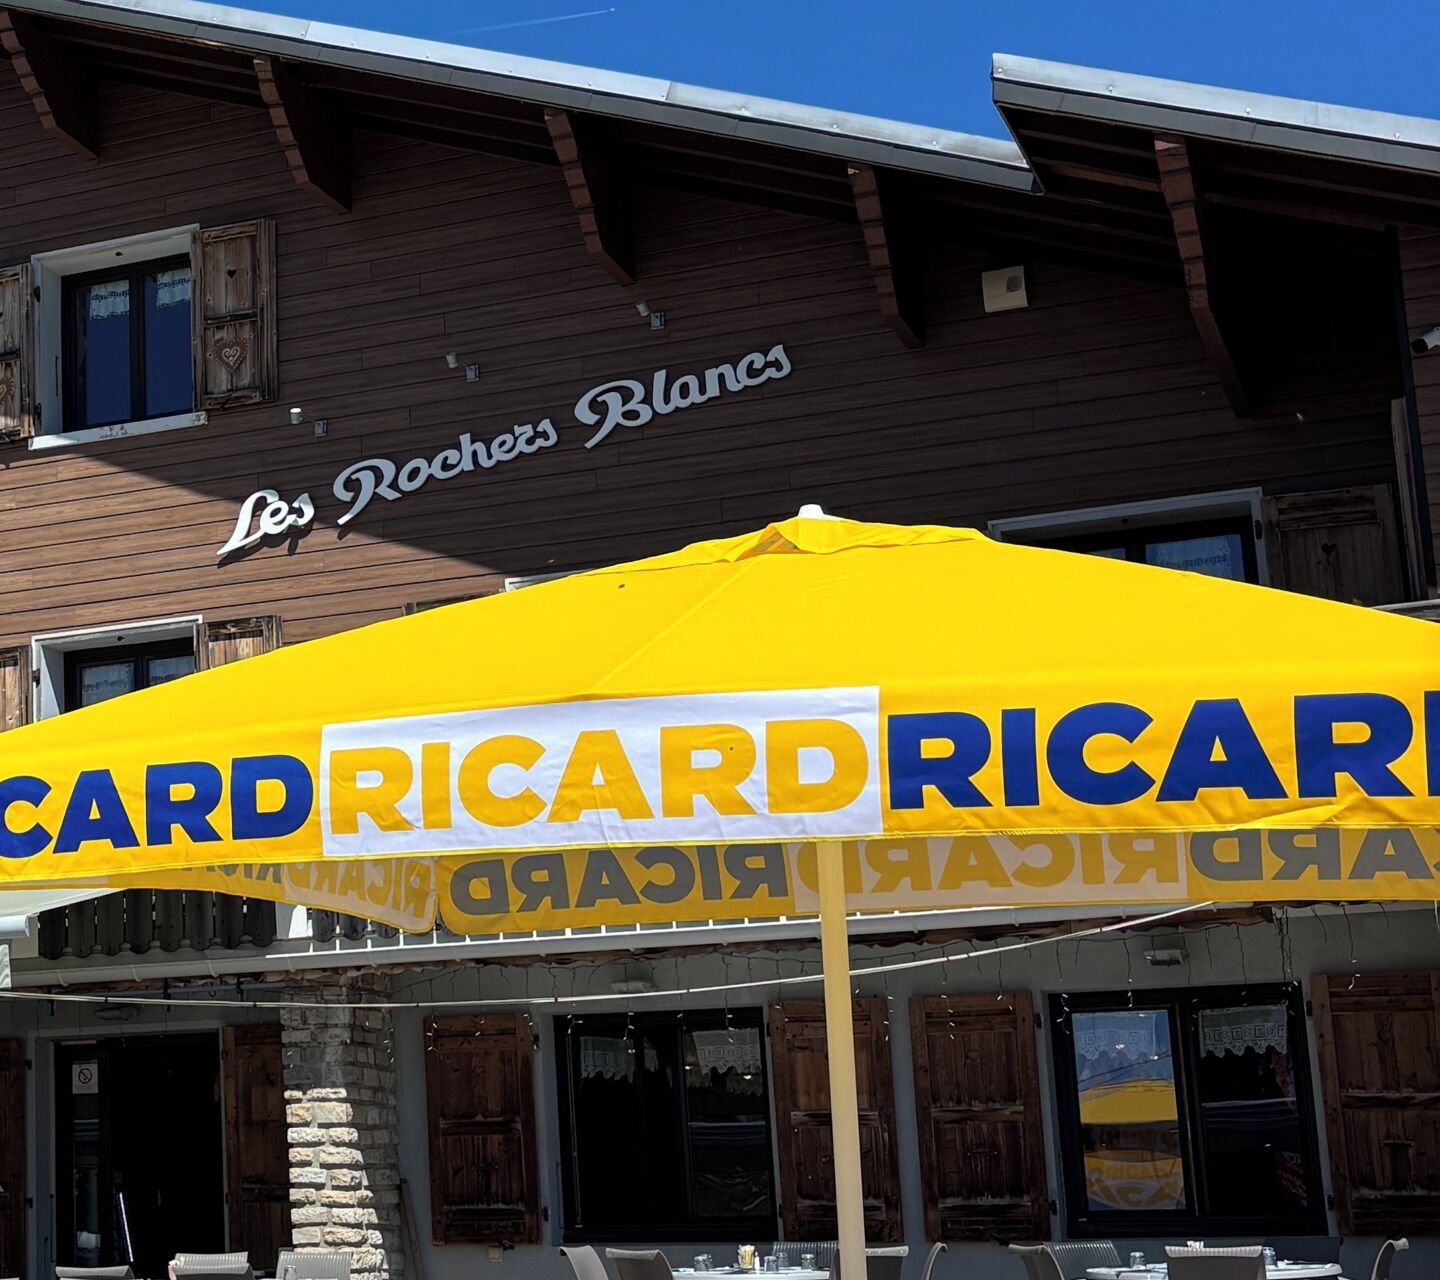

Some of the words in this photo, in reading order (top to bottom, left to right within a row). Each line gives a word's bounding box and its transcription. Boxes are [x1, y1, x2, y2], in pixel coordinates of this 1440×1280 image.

[216, 489, 315, 557] Les
[333, 418, 558, 526] Rochers
[574, 343, 792, 450] Blancs
[329, 718, 868, 834] RICARD
[888, 690, 1440, 809] RICAR
